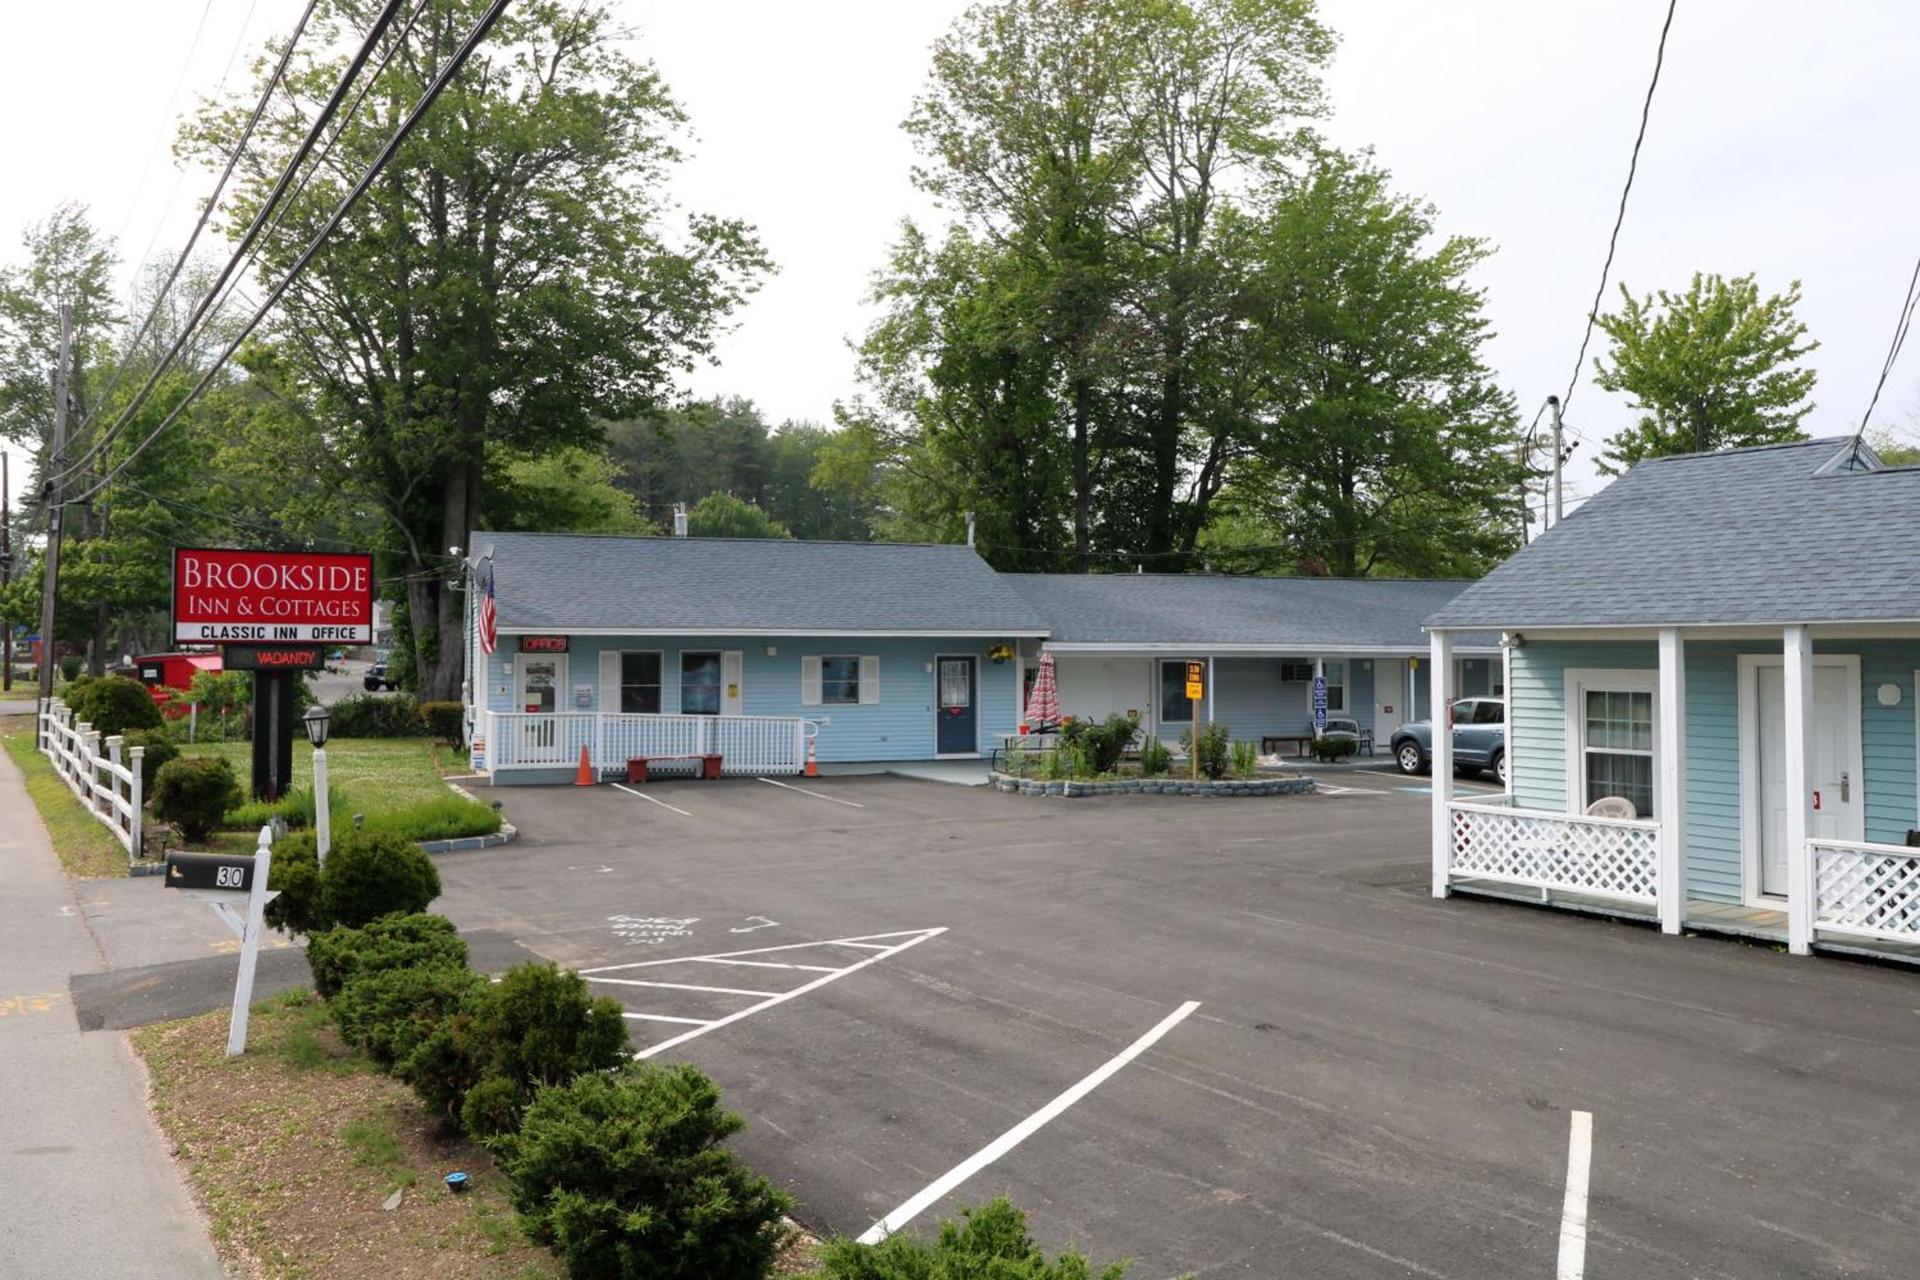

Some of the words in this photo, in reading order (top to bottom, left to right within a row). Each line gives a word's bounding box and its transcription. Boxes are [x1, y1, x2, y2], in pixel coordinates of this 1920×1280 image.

[184, 557, 367, 592] BROOKSIDE
[188, 595, 230, 615] INN
[237, 595, 254, 615] &
[259, 596, 360, 617] COTTAGES
[201, 625, 266, 640] CLASSIC
[273, 626, 298, 640] INN
[311, 627, 357, 640] OFFICE
[218, 867, 242, 886] 30
